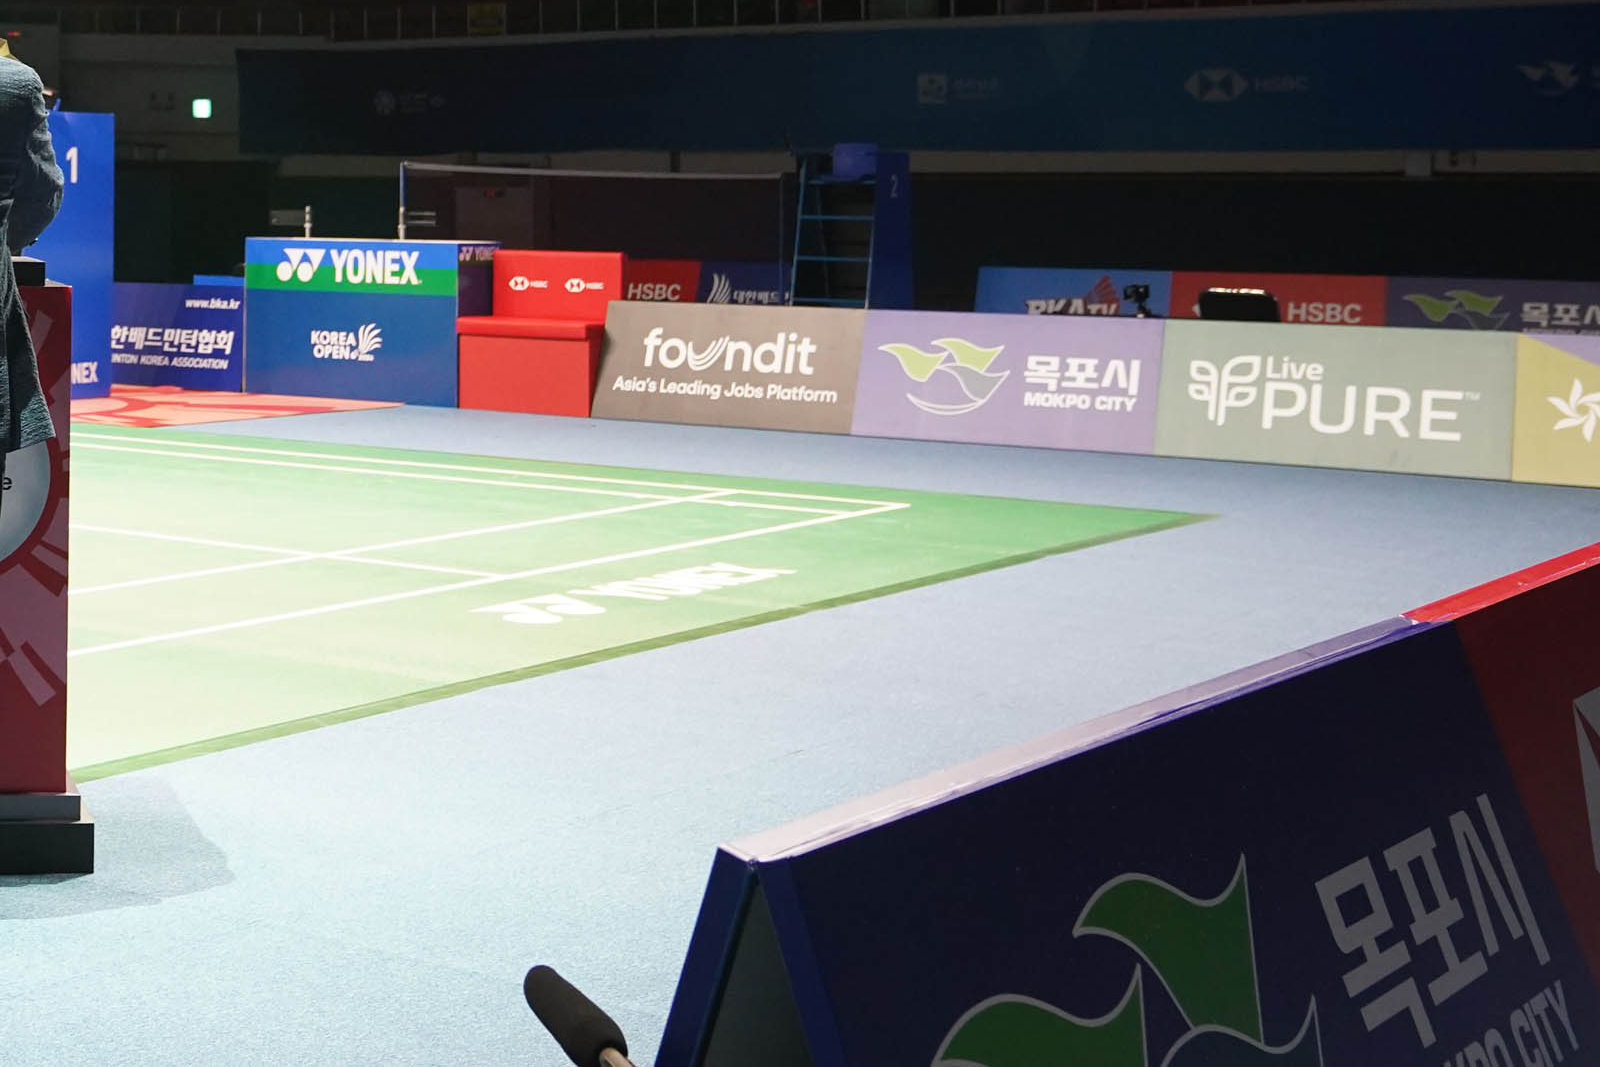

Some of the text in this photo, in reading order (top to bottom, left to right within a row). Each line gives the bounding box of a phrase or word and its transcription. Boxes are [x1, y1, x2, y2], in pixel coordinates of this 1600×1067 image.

[65, 146, 78, 184] 1
[330, 249, 419, 285] YONEX
[627, 283, 681, 301] HSBC
[1287, 302, 1361, 323] HSBC
[310, 330, 357, 346] KOREA
[139, 356, 169, 367] KOREA
[171, 358, 228, 370] ASSOCIATION
[313, 345, 350, 360] OPEN
[643, 328, 817, 375] foundit
[1024, 355, 1140, 395] 목포시
[1265, 356, 1324, 381] Live
[659, 379, 721, 400] Leading
[724, 384, 763, 399] Jobs
[766, 387, 837, 403] Platform
[1023, 390, 1137, 412] MOKPO CITY
[1261, 381, 1464, 441] PURE
[1314, 793, 1551, 1048] 목포시
